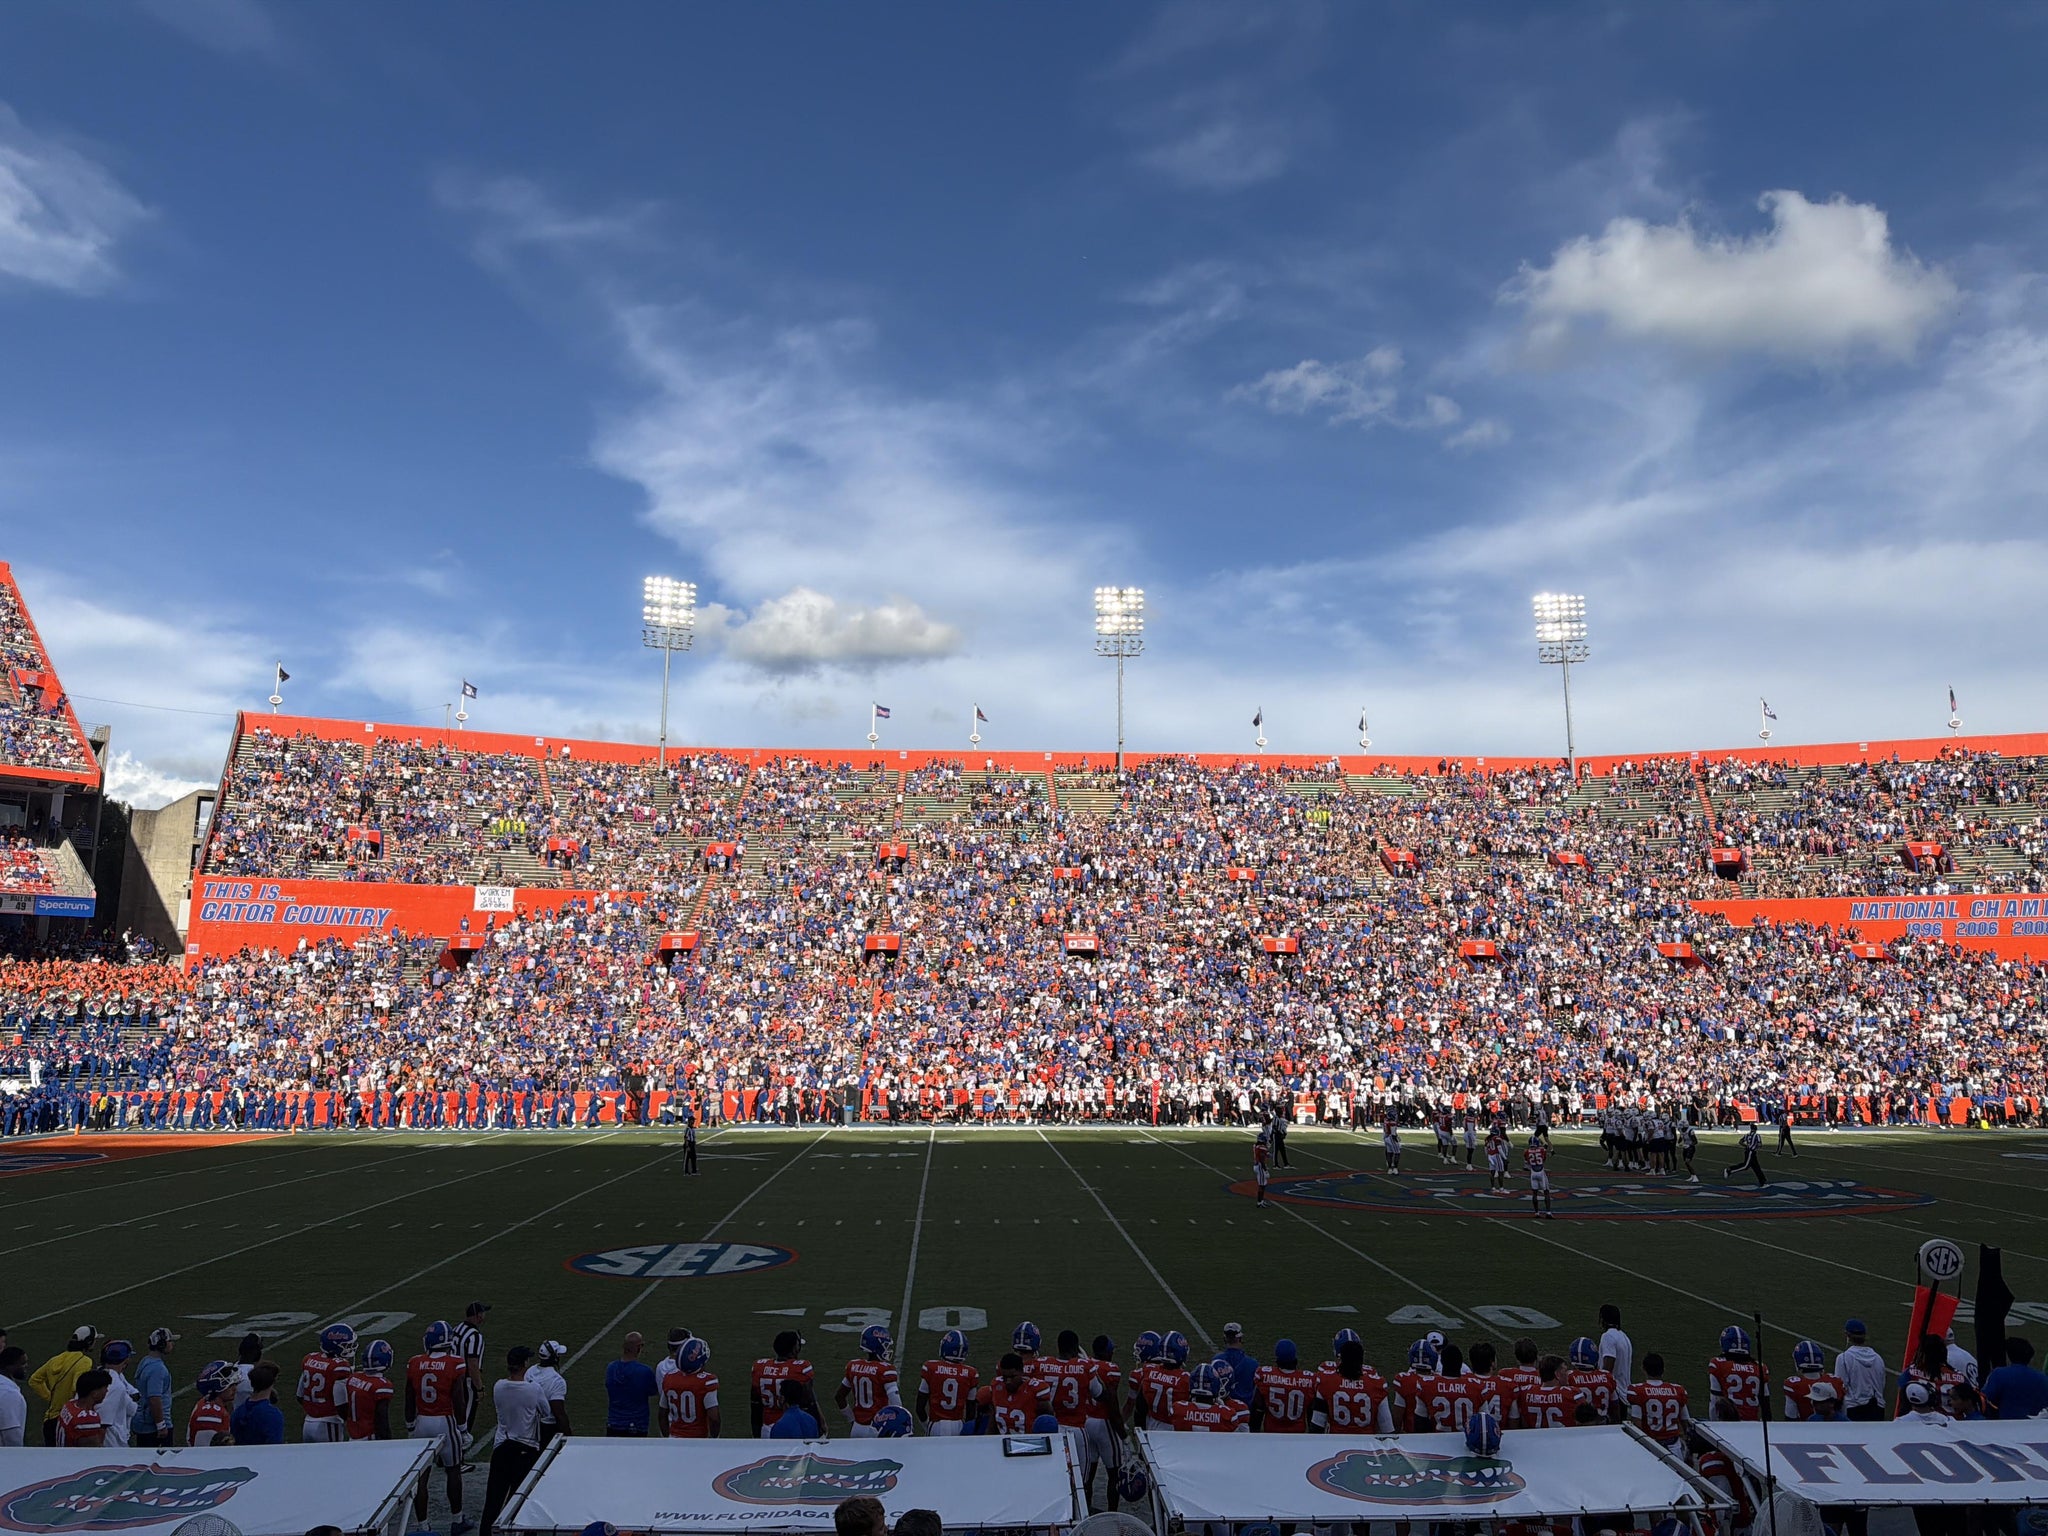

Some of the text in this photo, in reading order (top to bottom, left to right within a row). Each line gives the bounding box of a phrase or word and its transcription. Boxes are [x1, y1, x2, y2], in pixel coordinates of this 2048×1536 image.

[203, 882, 253, 899] THIS
[38, 899, 87, 912] Spectrum
[200, 902, 392, 927] GATOR COUNTRY
[1850, 900, 1960, 921] NATIONAL
[1906, 921, 1943, 937] 1996
[1955, 920, 1999, 937] 2006
[1528, 1152, 1543, 1165] 25
[584, 1242, 779, 1278] SEC
[1928, 1247, 1959, 1275] SEC
[819, 1307, 988, 1333] 30
[1385, 1304, 1561, 1330] 40
[419, 1360, 446, 1371] WILSON
[778, 1366, 789, 1377] JR
[850, 1363, 879, 1376] WILLIAMS
[934, 1365, 969, 1377] JONES JR
[1039, 1364, 1063, 1374] PIERRE
[1064, 1364, 1085, 1375] LOUIS
[1731, 1363, 1755, 1374] JONES
[303, 1369, 327, 1403] 22
[420, 1372, 438, 1404] 6
[1149, 1370, 1181, 1387] KEARNEY
[1339, 1379, 1364, 1390] JONES
[1437, 1382, 1467, 1394] CLARK
[1513, 1373, 1542, 1385] GRIFFIN
[1573, 1374, 1608, 1385] WILLIAMS
[1725, 1373, 1762, 1407] 23
[853, 1376, 874, 1409] 10
[939, 1377, 960, 1410] 9
[1043, 1375, 1080, 1409] 73
[1150, 1382, 1174, 1417] 71
[1268, 1386, 1305, 1421] 50
[1525, 1392, 1563, 1404] FAIRCLOTH
[666, 1388, 697, 1424] 60
[1183, 1410, 1221, 1424] JACKSON
[1332, 1390, 1372, 1428] 63
[1431, 1396, 1475, 1432] 20
[1645, 1398, 1681, 1432] 82
[994, 1405, 1026, 1434] 53
